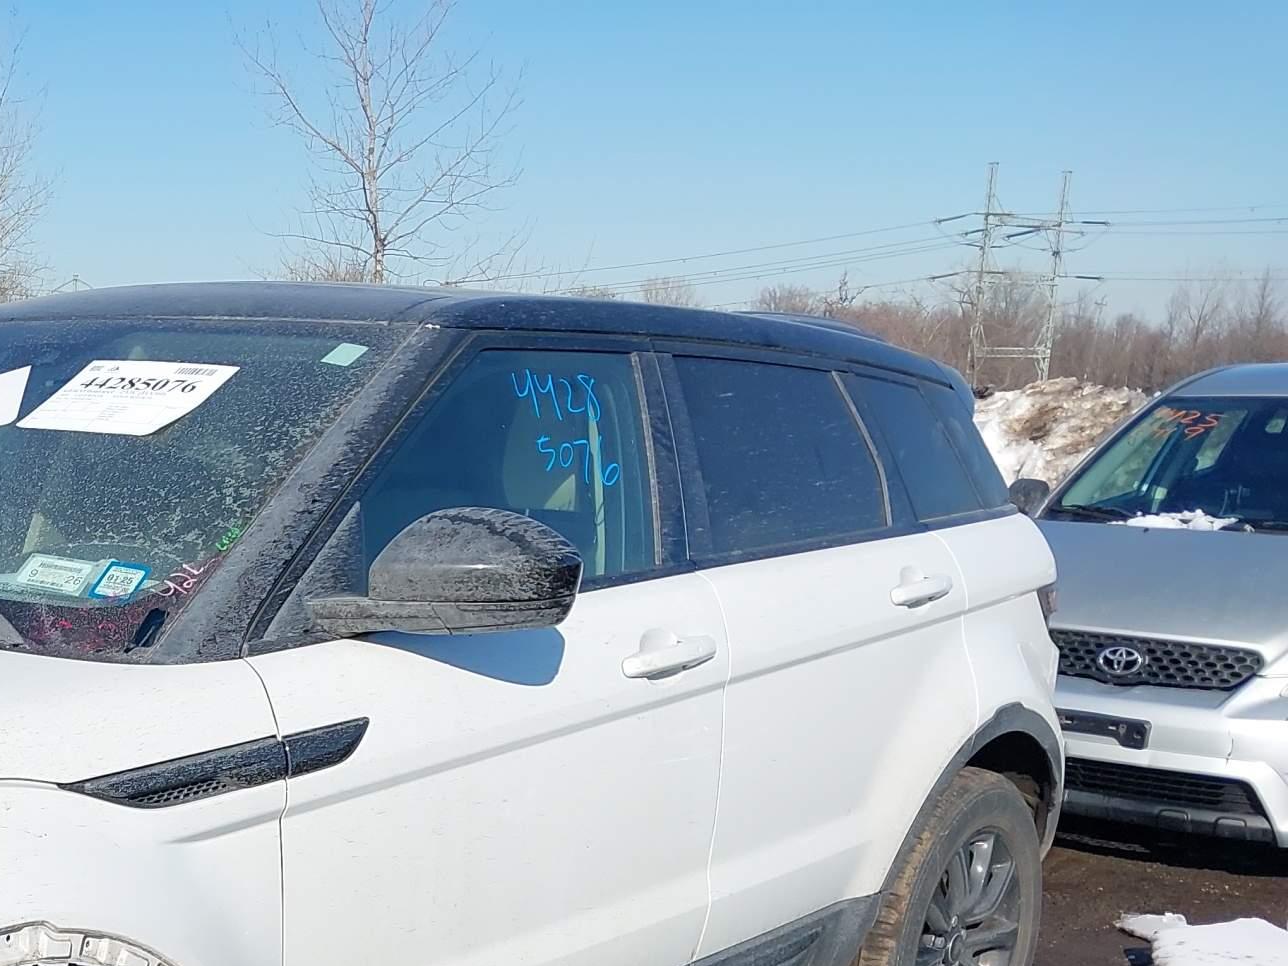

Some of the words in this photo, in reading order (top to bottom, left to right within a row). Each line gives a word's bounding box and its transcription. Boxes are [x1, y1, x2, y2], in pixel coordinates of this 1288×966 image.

[80, 376, 203, 394] 44285076
[511, 368, 600, 421] 4428
[536, 435, 620, 486] 5076
[63, 575, 83, 586] 26
